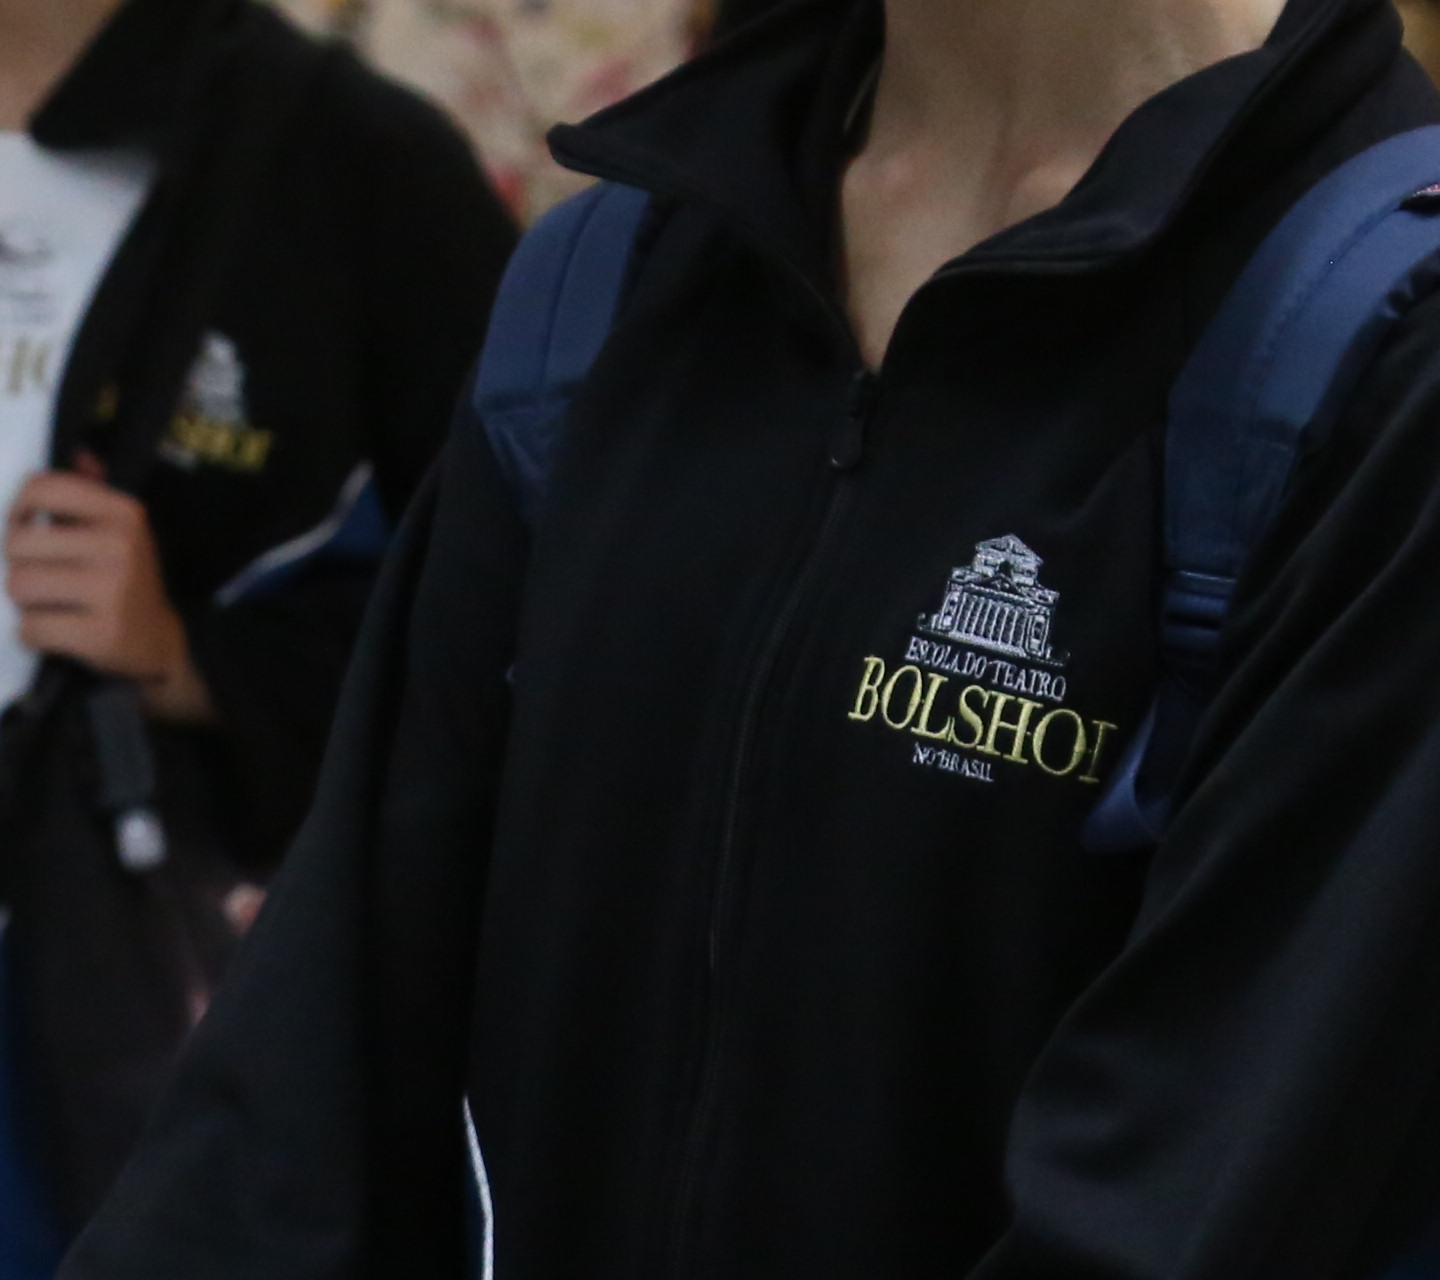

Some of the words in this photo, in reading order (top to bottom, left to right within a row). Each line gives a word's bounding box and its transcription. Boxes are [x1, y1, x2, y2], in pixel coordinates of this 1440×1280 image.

[904, 636, 965, 674] ESCOLA
[963, 655, 988, 681] DO
[990, 657, 1068, 702] TEATRO
[848, 654, 1118, 784] BOLSHOI
[911, 742, 937, 767] NO
[936, 745, 995, 783] BRASIL
